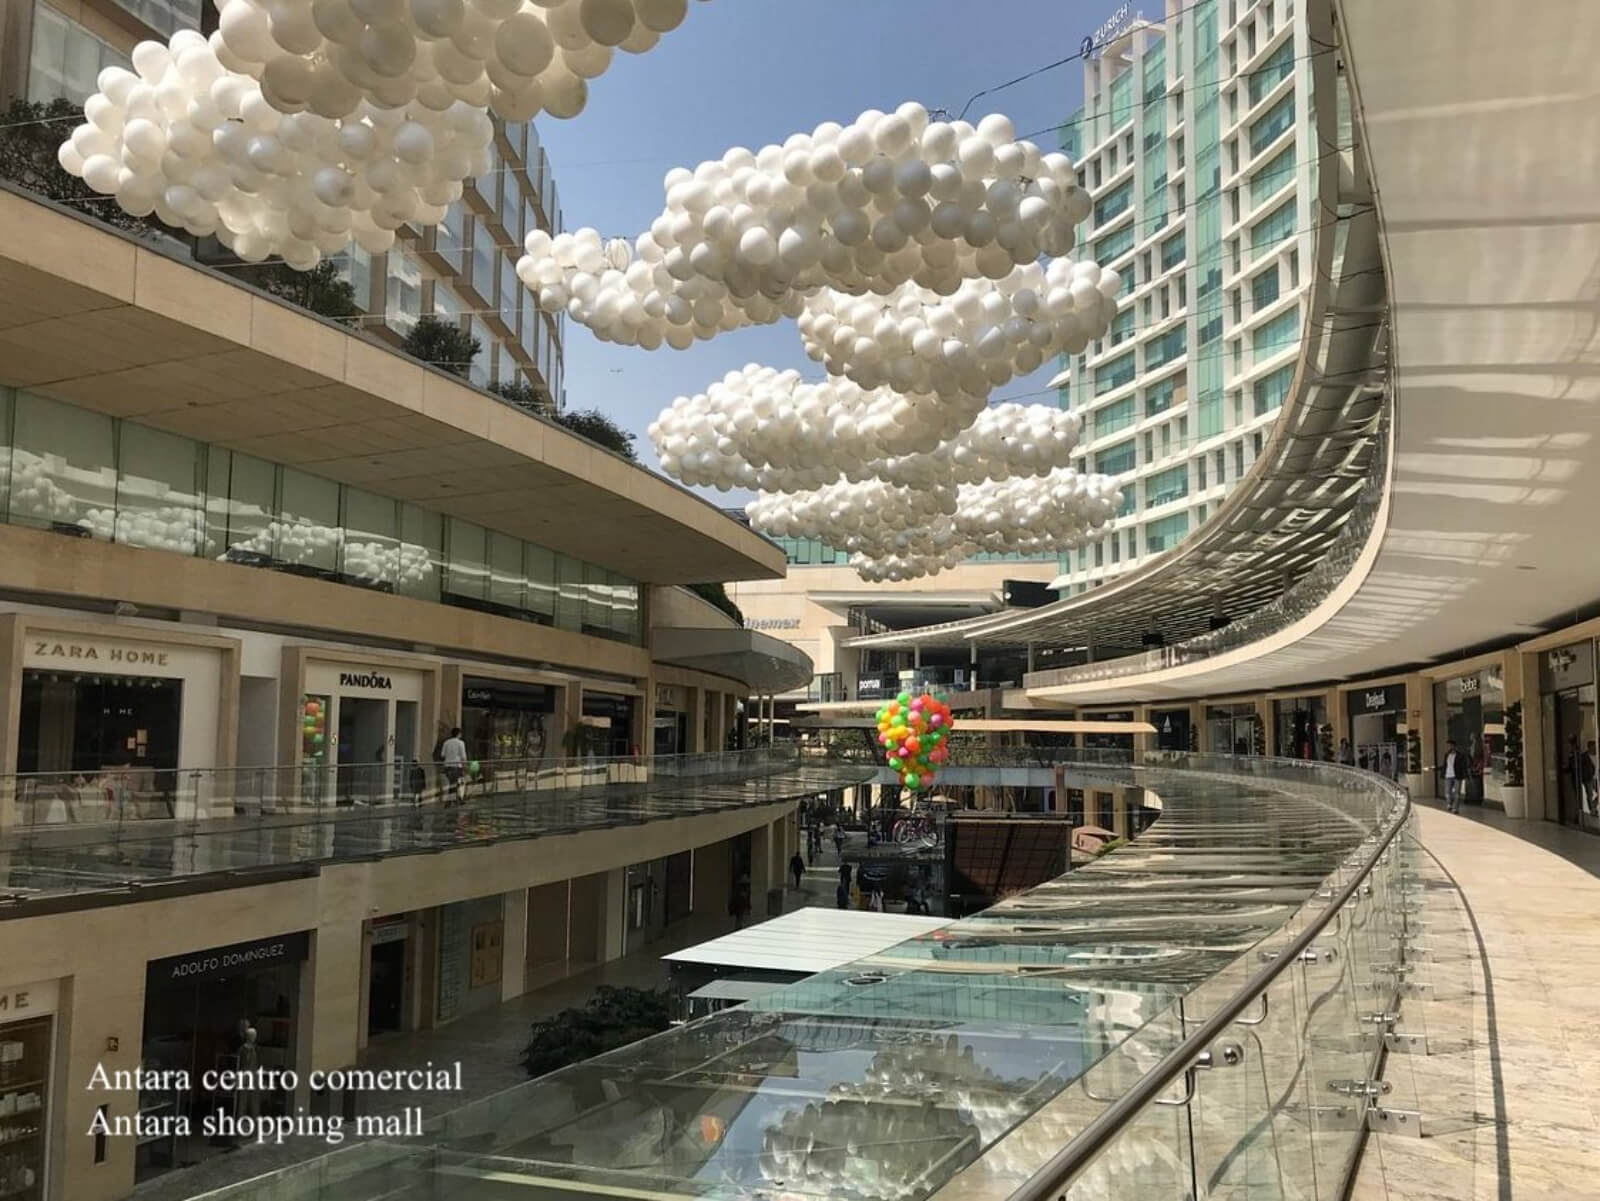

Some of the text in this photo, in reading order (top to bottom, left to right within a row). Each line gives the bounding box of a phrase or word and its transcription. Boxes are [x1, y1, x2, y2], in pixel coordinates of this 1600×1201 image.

[1094, 3, 1129, 43] ZURICH
[744, 616, 801, 630] inemex
[34, 641, 169, 667] ZARA HOME
[171, 943, 285, 978] ADOLFO DOMINGUEZ
